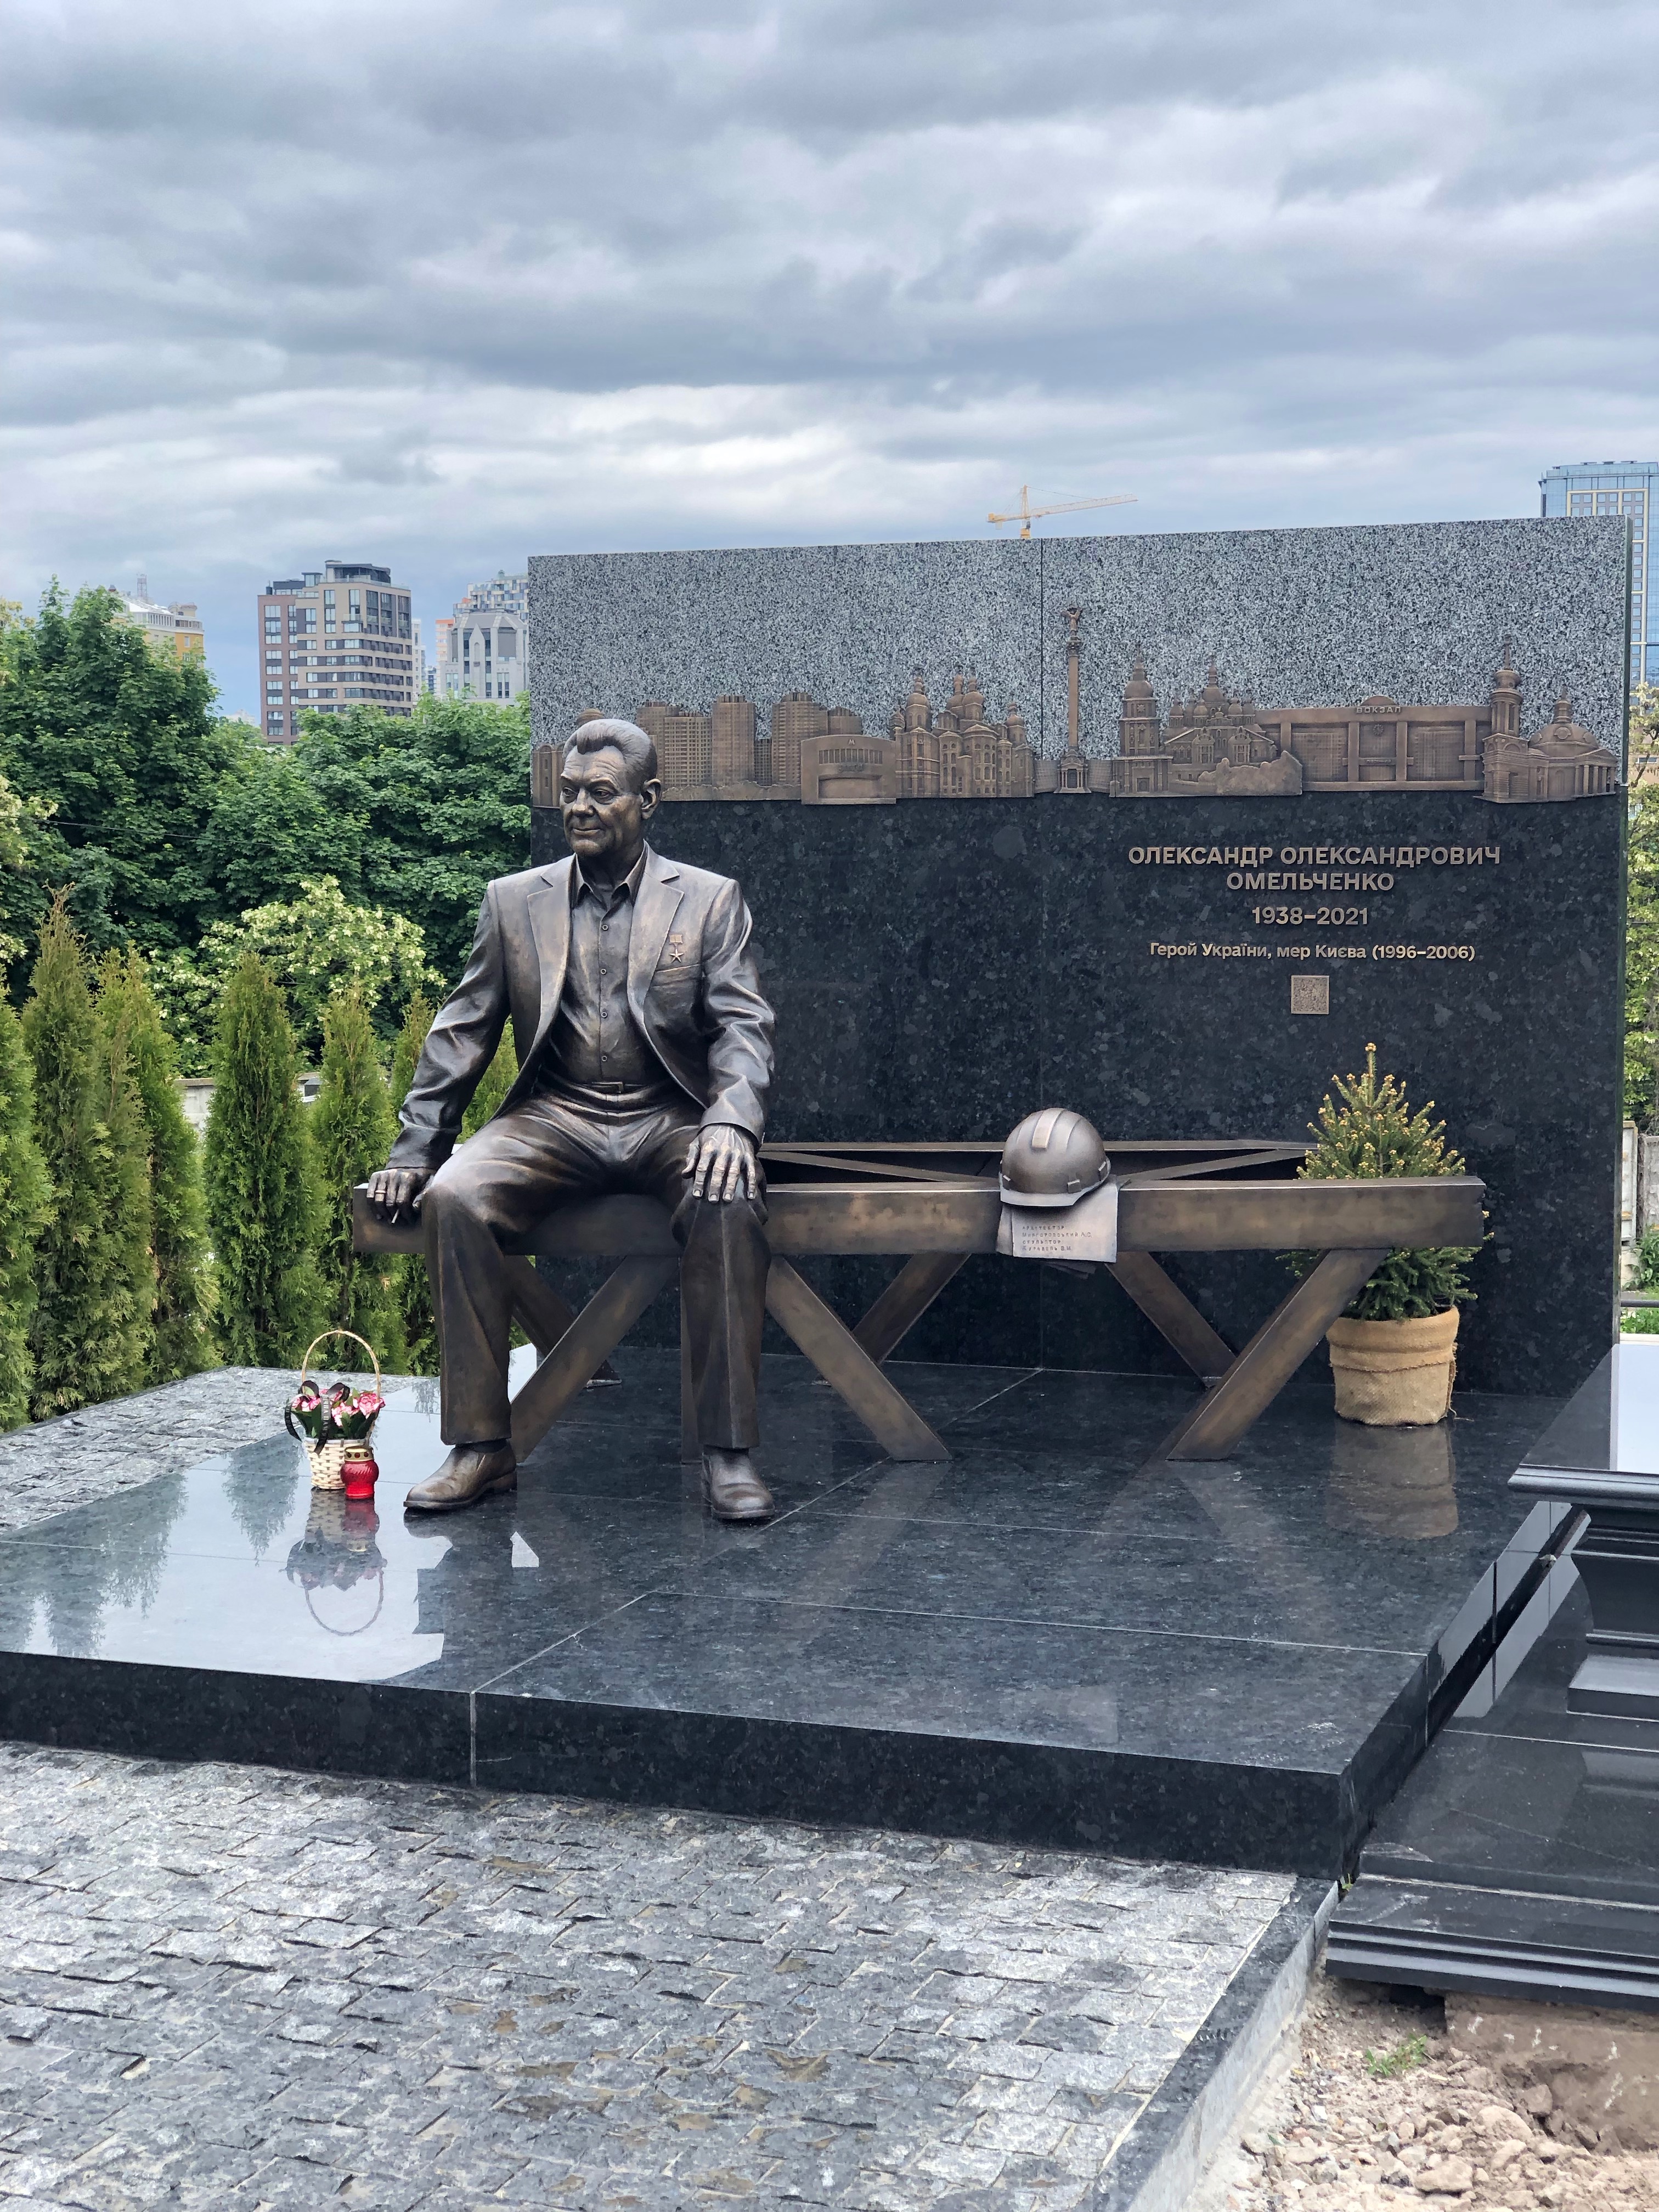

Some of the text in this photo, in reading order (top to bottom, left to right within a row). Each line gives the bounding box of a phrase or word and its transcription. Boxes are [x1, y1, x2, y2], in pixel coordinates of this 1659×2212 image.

[1128, 847, 1500, 868] ОЛЕКСАНДР ОЛЕКСАНДРОВИЧ
[1227, 872, 1394, 891] ОМЕЛЬЧЕНКО
[1150, 942, 1197, 959] Герой
[1201, 943, 1272, 960] України,
[1277, 946, 1311, 960] мер
[1316, 945, 1366, 958] Києва
